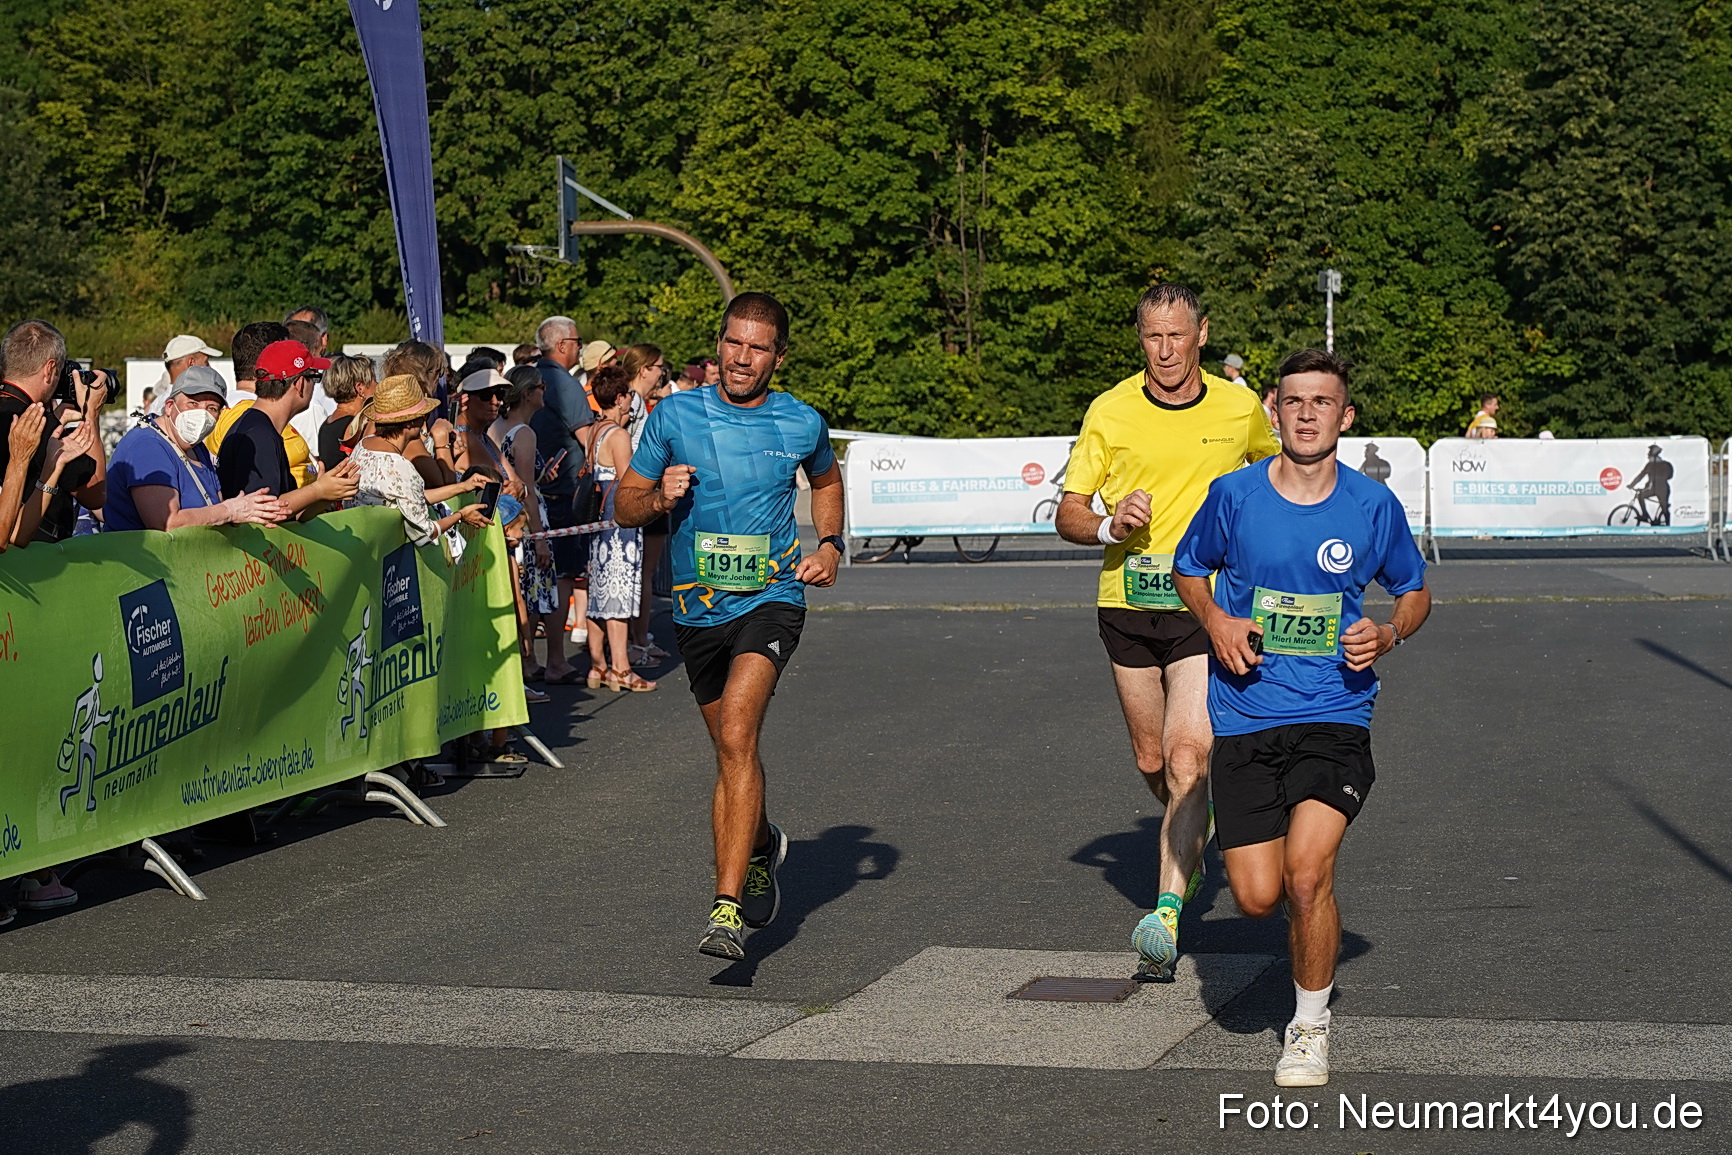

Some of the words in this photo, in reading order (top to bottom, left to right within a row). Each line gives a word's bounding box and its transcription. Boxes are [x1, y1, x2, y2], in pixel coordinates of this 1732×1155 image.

[775, 450, 801, 460] PLAST
[870, 458, 906, 472] NOW
[1452, 460, 1487, 473] NOW
[873, 480, 926, 494] E-BIKES
[928, 481, 940, 492] &
[942, 476, 1024, 491] FAHRRÄDER
[1454, 482, 1505, 495] E-BIKES
[1507, 483, 1518, 495] &
[1521, 481, 1601, 495] FAHRRÄDER
[698, 557, 706, 577] RUN
[706, 552, 758, 573] 1914
[757, 557, 766, 583] 2022
[206, 550, 266, 608] Gesunde
[263, 543, 308, 582] Firmen
[707, 571, 729, 581] Meyer
[729, 573, 756, 582] Jochen
[1138, 572, 1174, 592] 548
[386, 576, 411, 600] Fischer
[242, 597, 281, 648] laufen
[279, 571, 325, 634] länger!
[136, 618, 172, 647] Fischer
[1266, 612, 1326, 636] 1753
[1325, 618, 1337, 647] 2022
[142, 637, 172, 657] AUTOMOBILE
[1271, 634, 1292, 643] Hierl
[1293, 636, 1317, 645] Mirco
[371, 622, 442, 706] firmenla
[107, 655, 229, 772] firmenlauf
[370, 691, 405, 728] neumarkt
[104, 753, 158, 800] neumarkt
[181, 738, 315, 806] www.firmenlauf-oberpfalz.de
